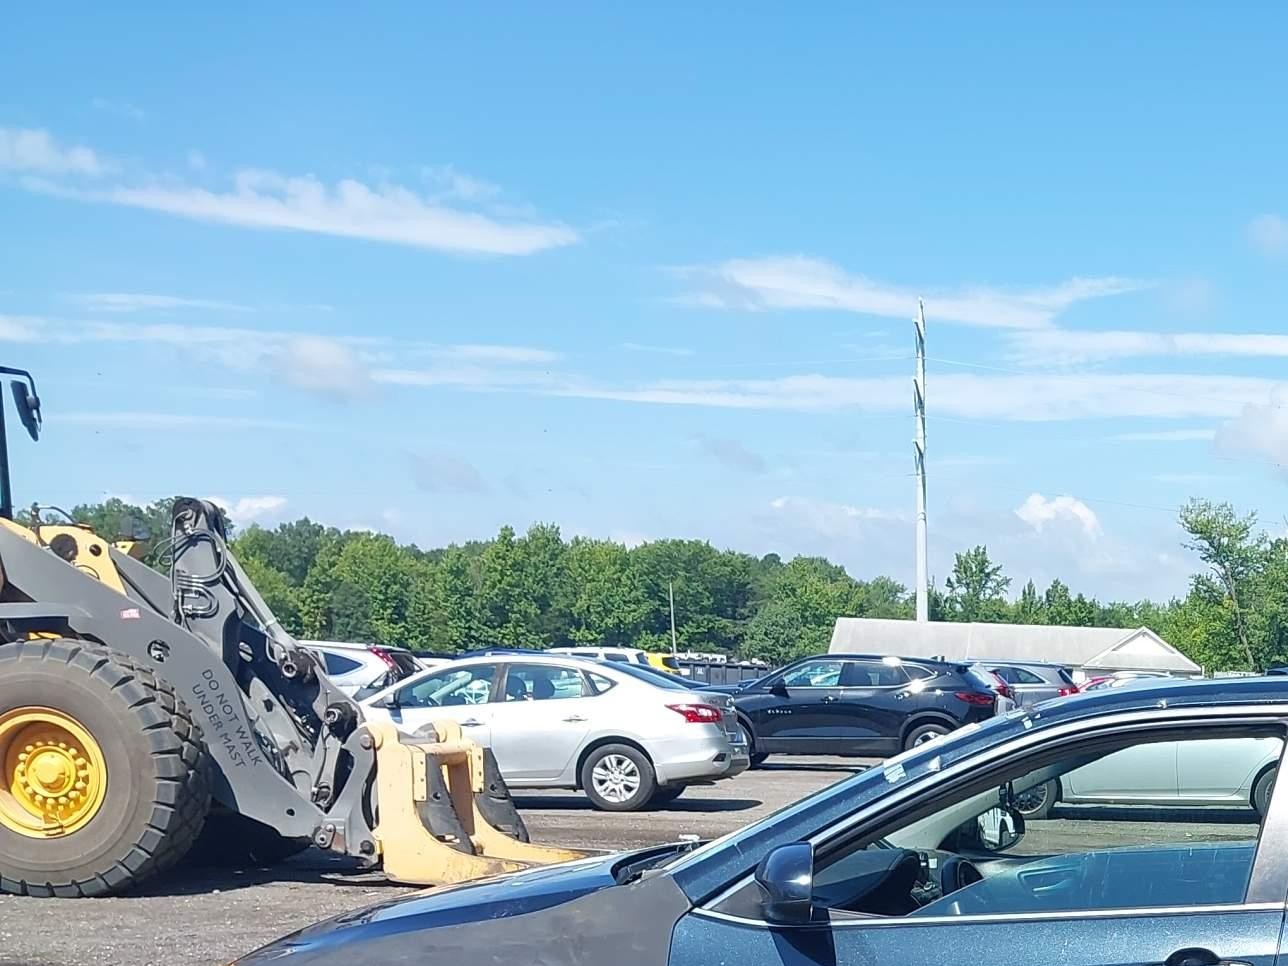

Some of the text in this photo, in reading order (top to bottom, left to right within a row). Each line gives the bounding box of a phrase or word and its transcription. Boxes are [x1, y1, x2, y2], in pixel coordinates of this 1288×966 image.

[192, 684, 246, 767] UNDER MAST
[202, 669, 263, 766] DO NOT WALK
